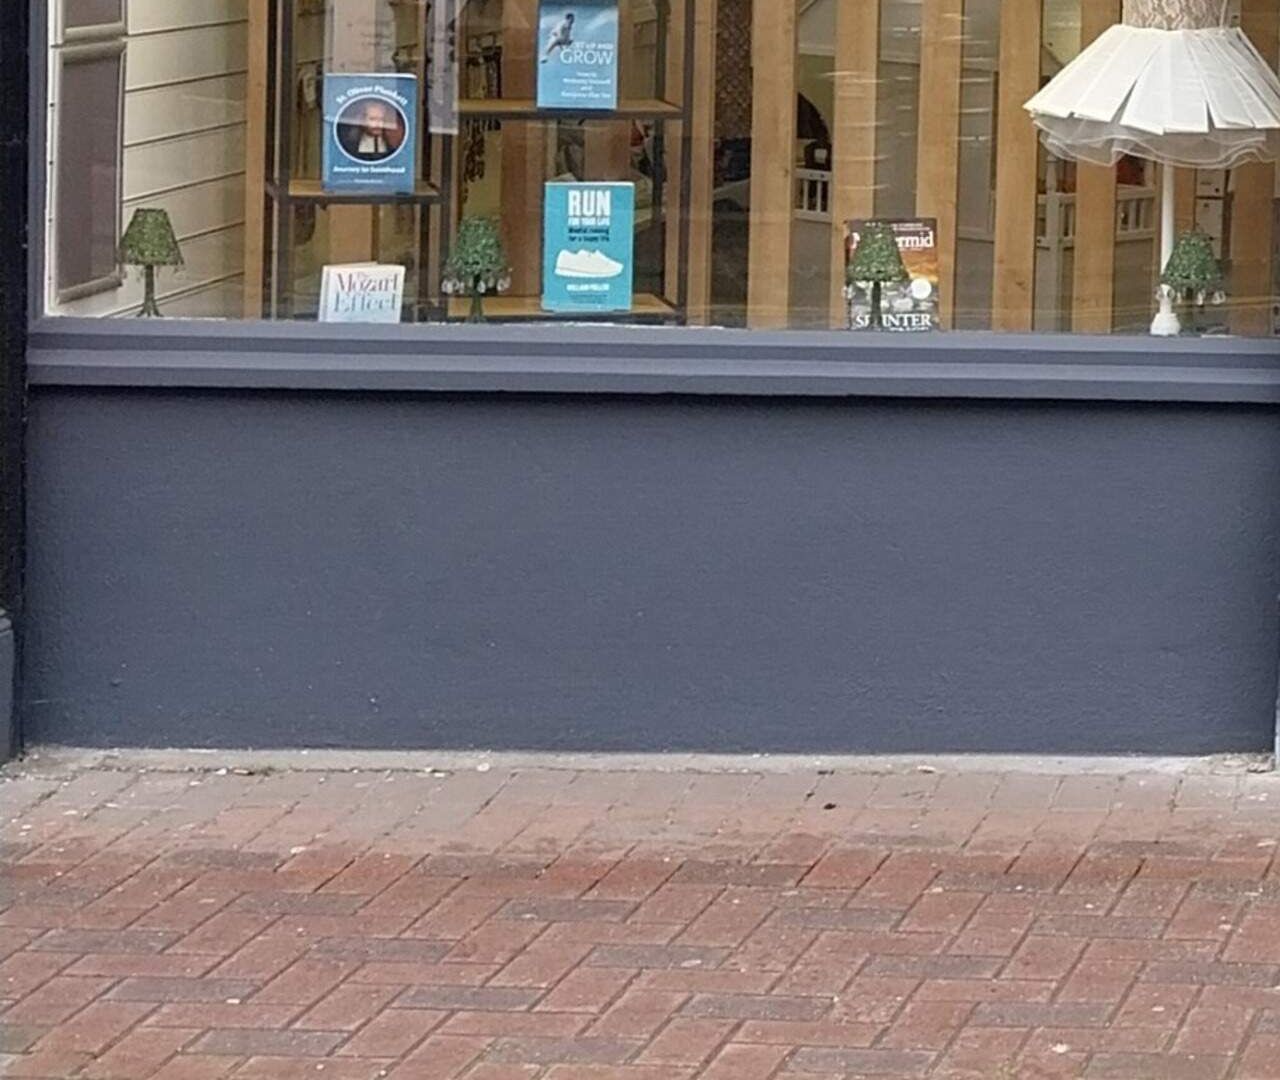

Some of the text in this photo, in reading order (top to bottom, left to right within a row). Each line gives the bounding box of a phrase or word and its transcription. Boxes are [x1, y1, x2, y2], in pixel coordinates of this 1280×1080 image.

[560, 49, 614, 65] GROW
[567, 189, 611, 217] RUN
[336, 272, 398, 293] Mozart
[334, 291, 396, 313] Effect
